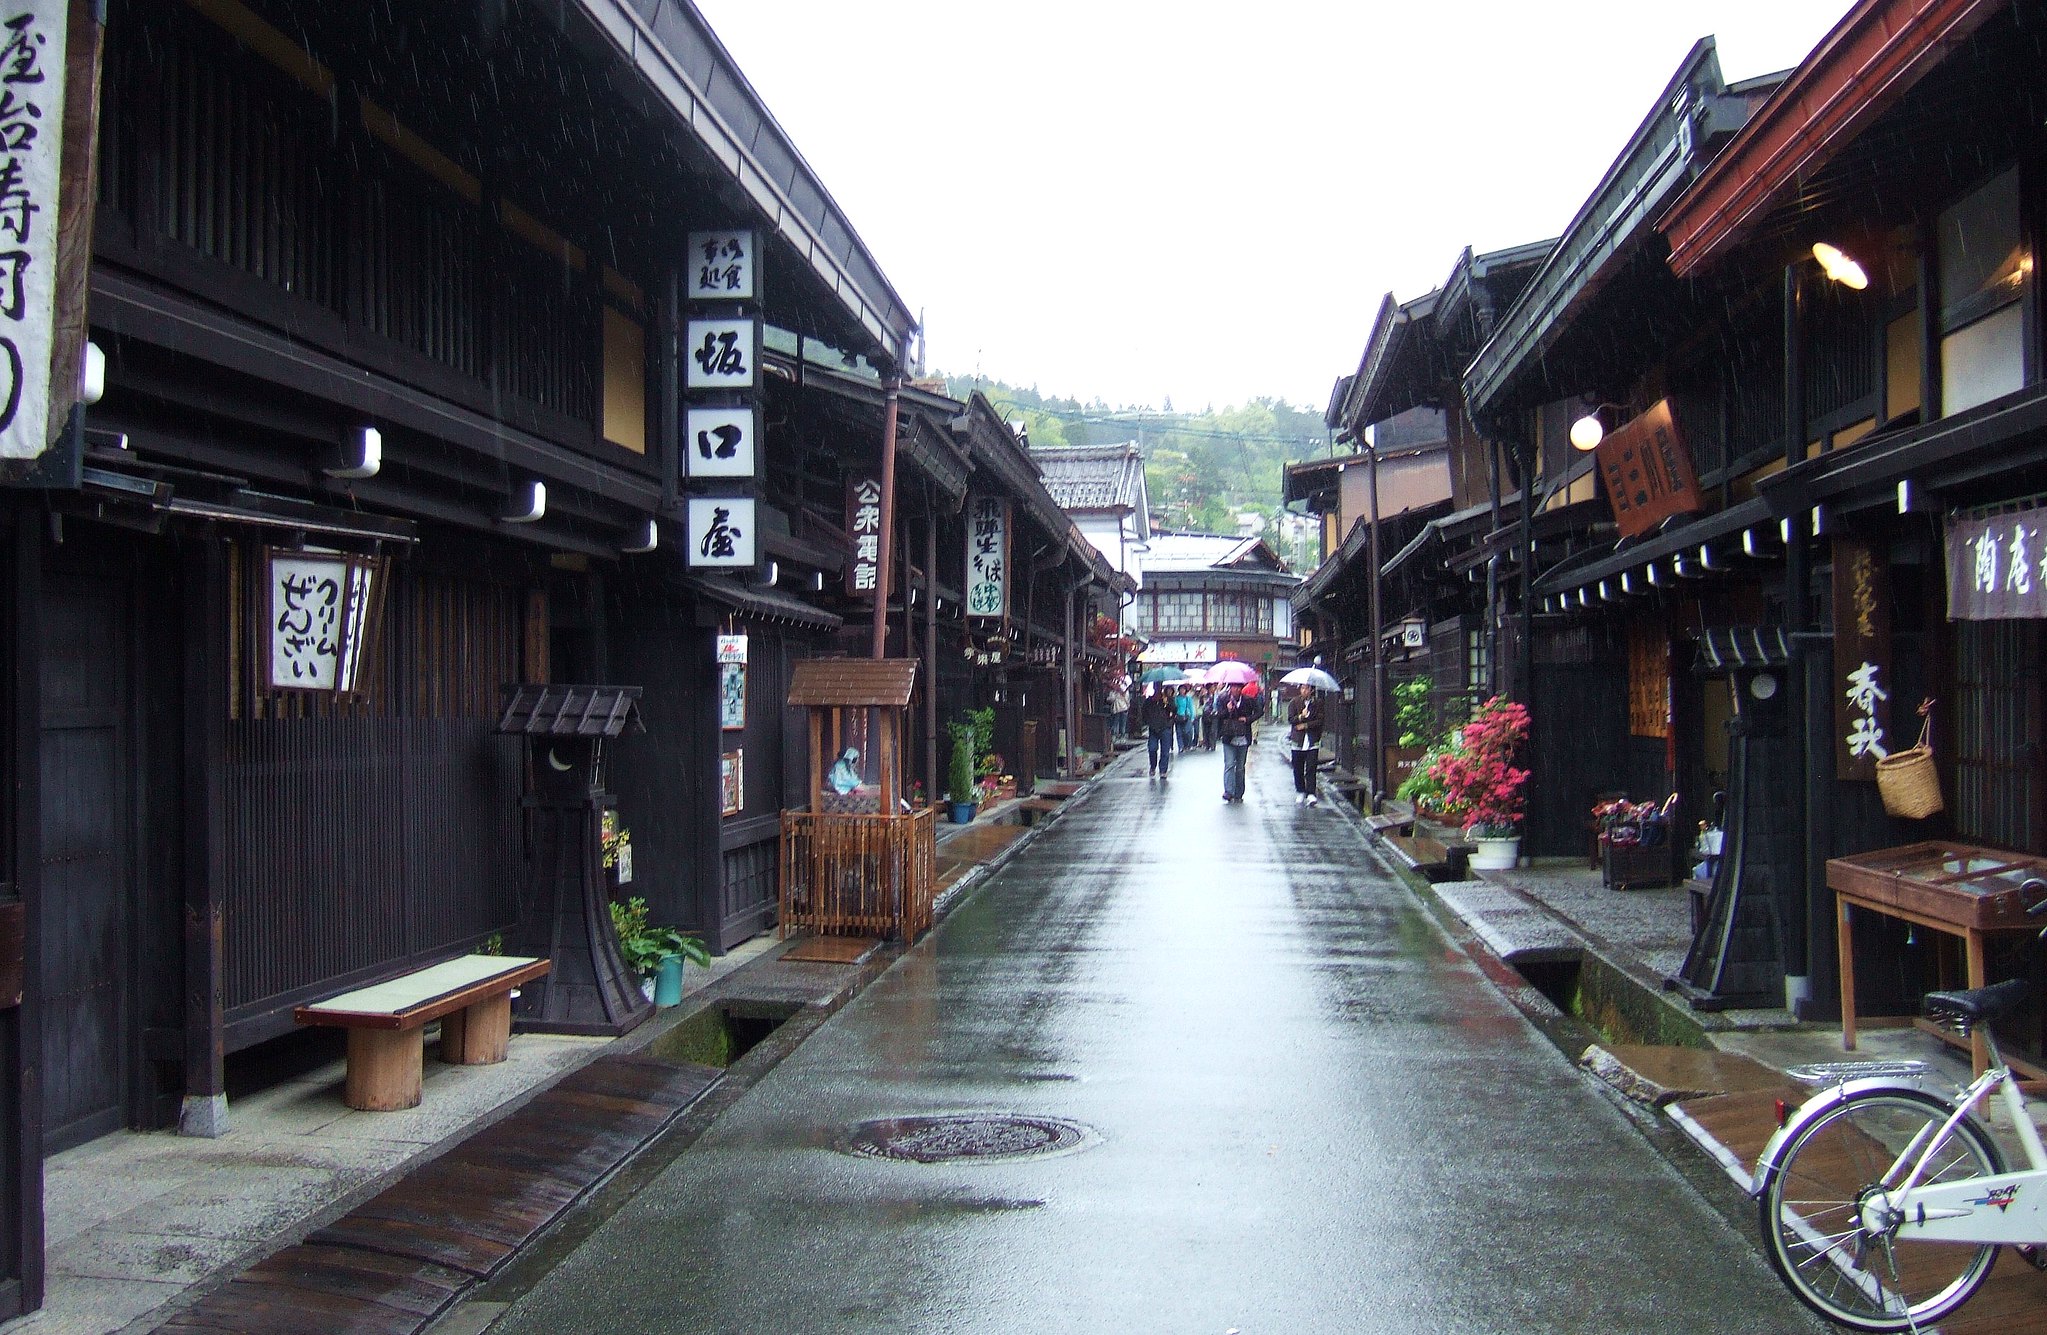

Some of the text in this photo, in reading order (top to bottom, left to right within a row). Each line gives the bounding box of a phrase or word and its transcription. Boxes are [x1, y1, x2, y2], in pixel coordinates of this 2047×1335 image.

[695, 331, 747, 557] 坂口屋
[853, 480, 880, 590] 公衆電話
[1974, 524, 2047, 595] 陶庵
[278, 573, 317, 678] ぜんざい
[1846, 661, 1887, 760] 春秋
